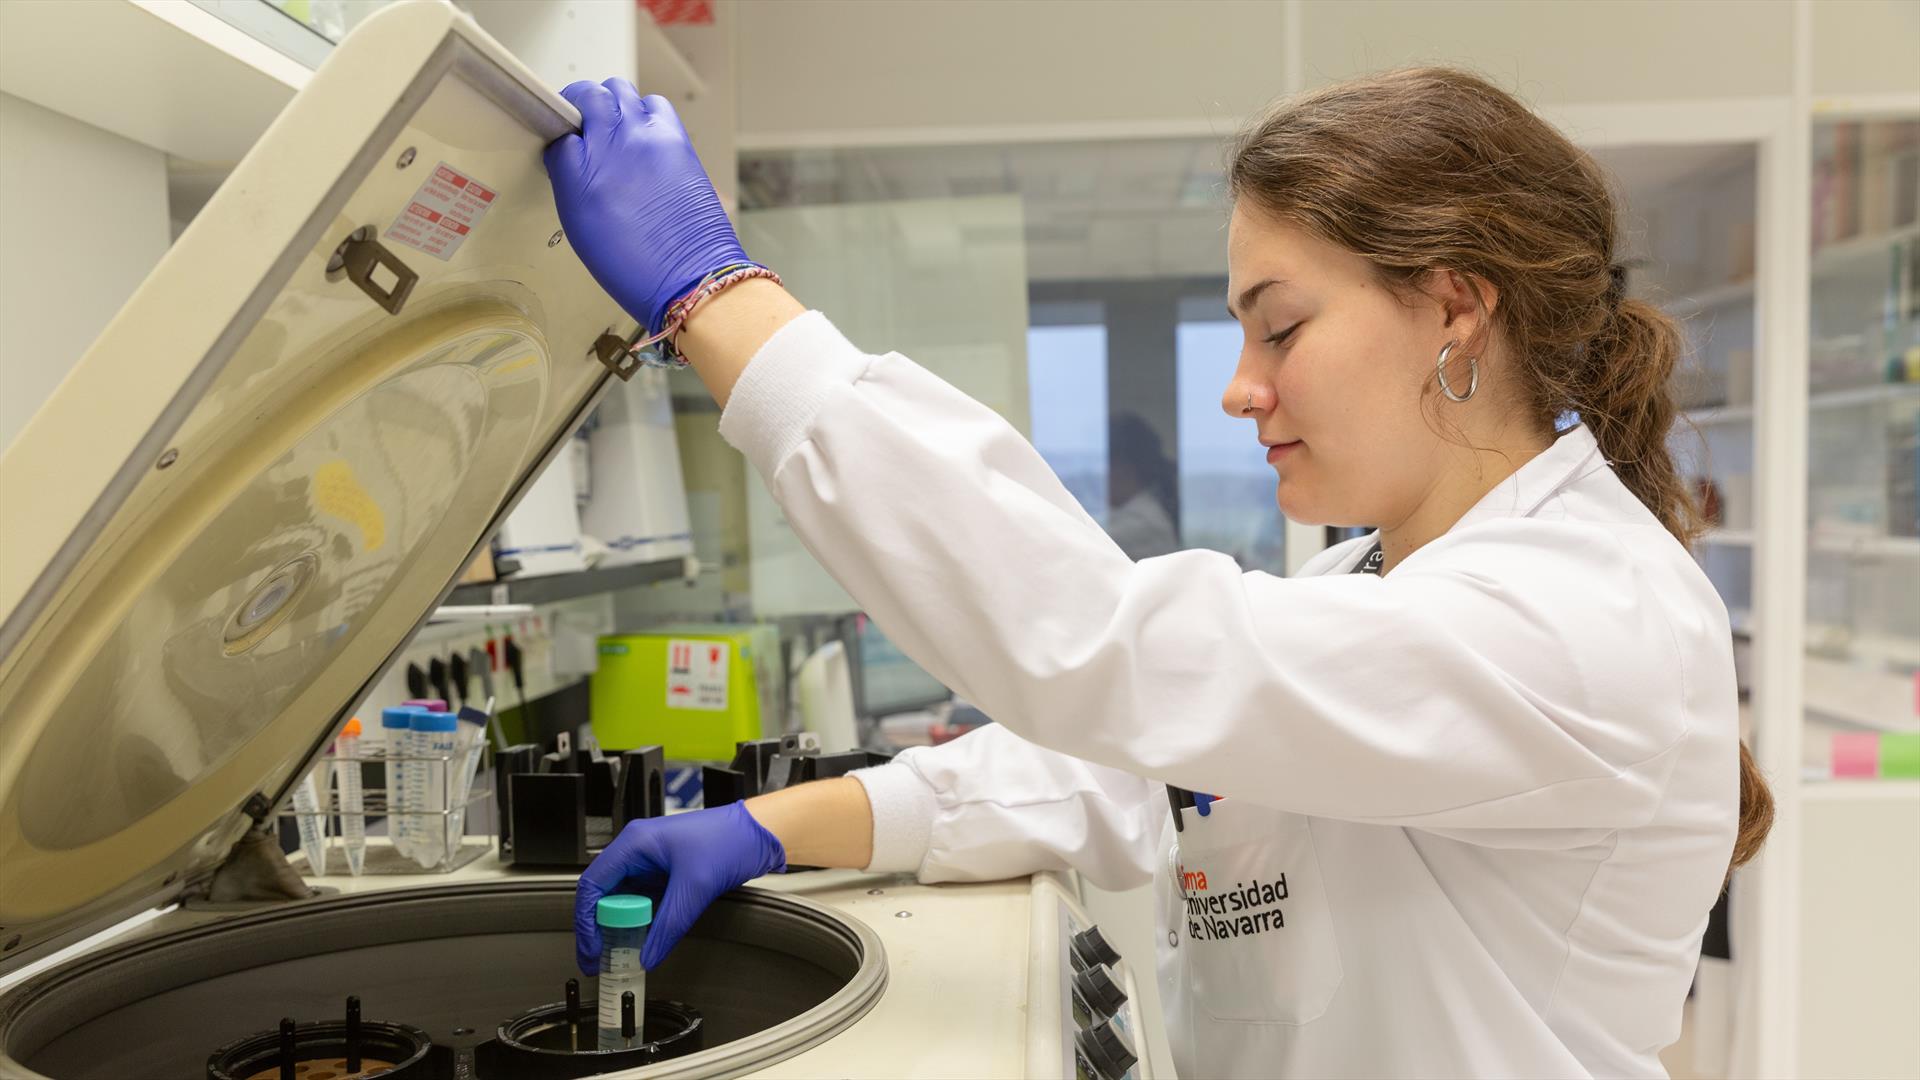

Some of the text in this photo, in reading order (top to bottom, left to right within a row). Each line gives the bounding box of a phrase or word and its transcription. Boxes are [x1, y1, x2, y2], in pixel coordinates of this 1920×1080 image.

[1360, 551, 1384, 574] ra
[1180, 865, 1207, 890] ima
[1187, 872, 1288, 915] niversidad
[1188, 909, 1284, 940] de Navarra
